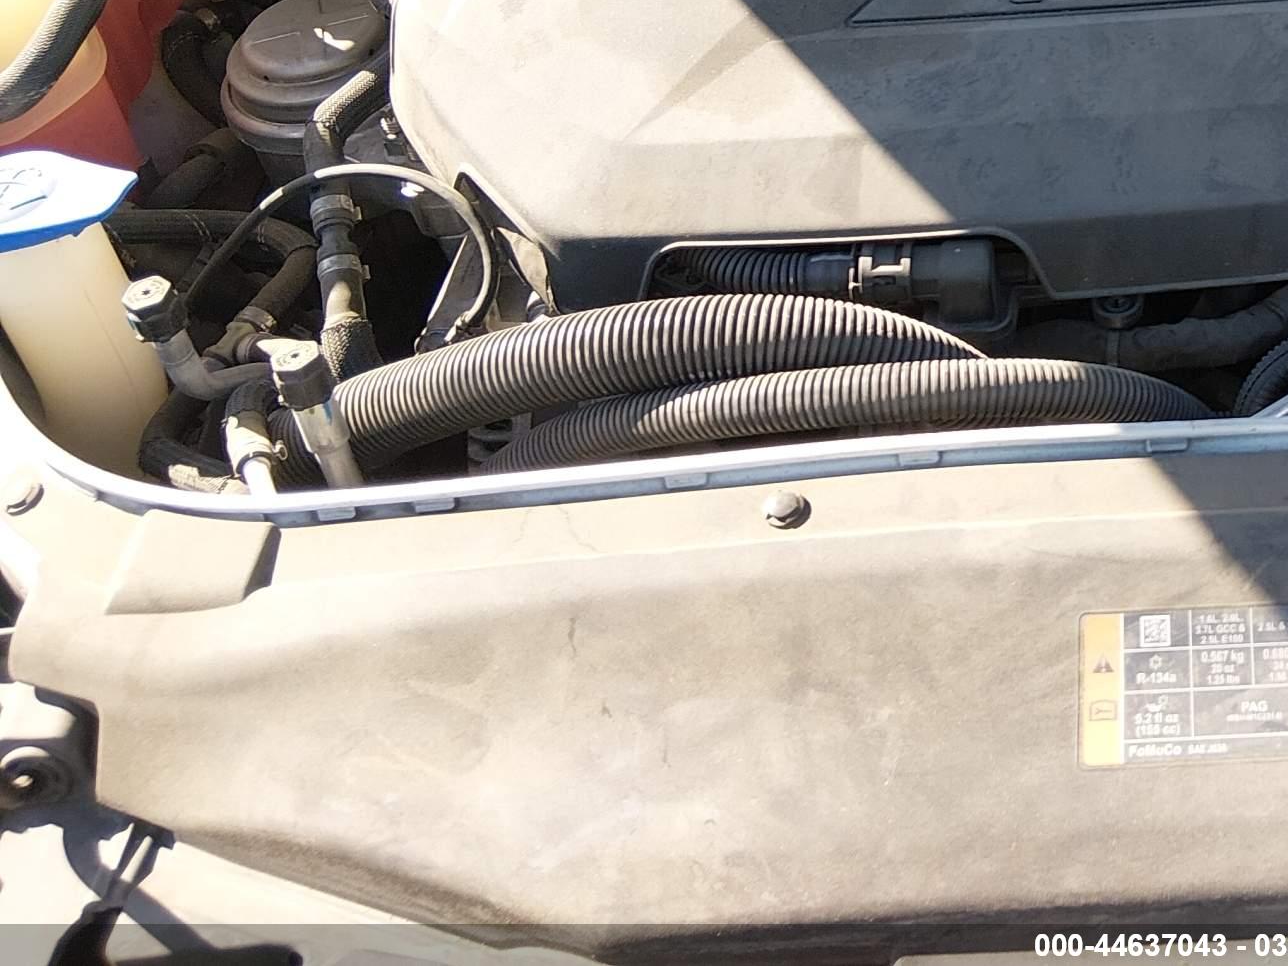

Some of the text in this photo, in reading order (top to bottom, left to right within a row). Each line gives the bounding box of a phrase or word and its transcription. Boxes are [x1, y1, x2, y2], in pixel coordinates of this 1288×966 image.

[1230, 649, 1244, 665] kg
[1136, 672, 1177, 685] R-134a
[1241, 700, 1268, 713] PAG
[1128, 743, 1182, 758] FoMoCo
